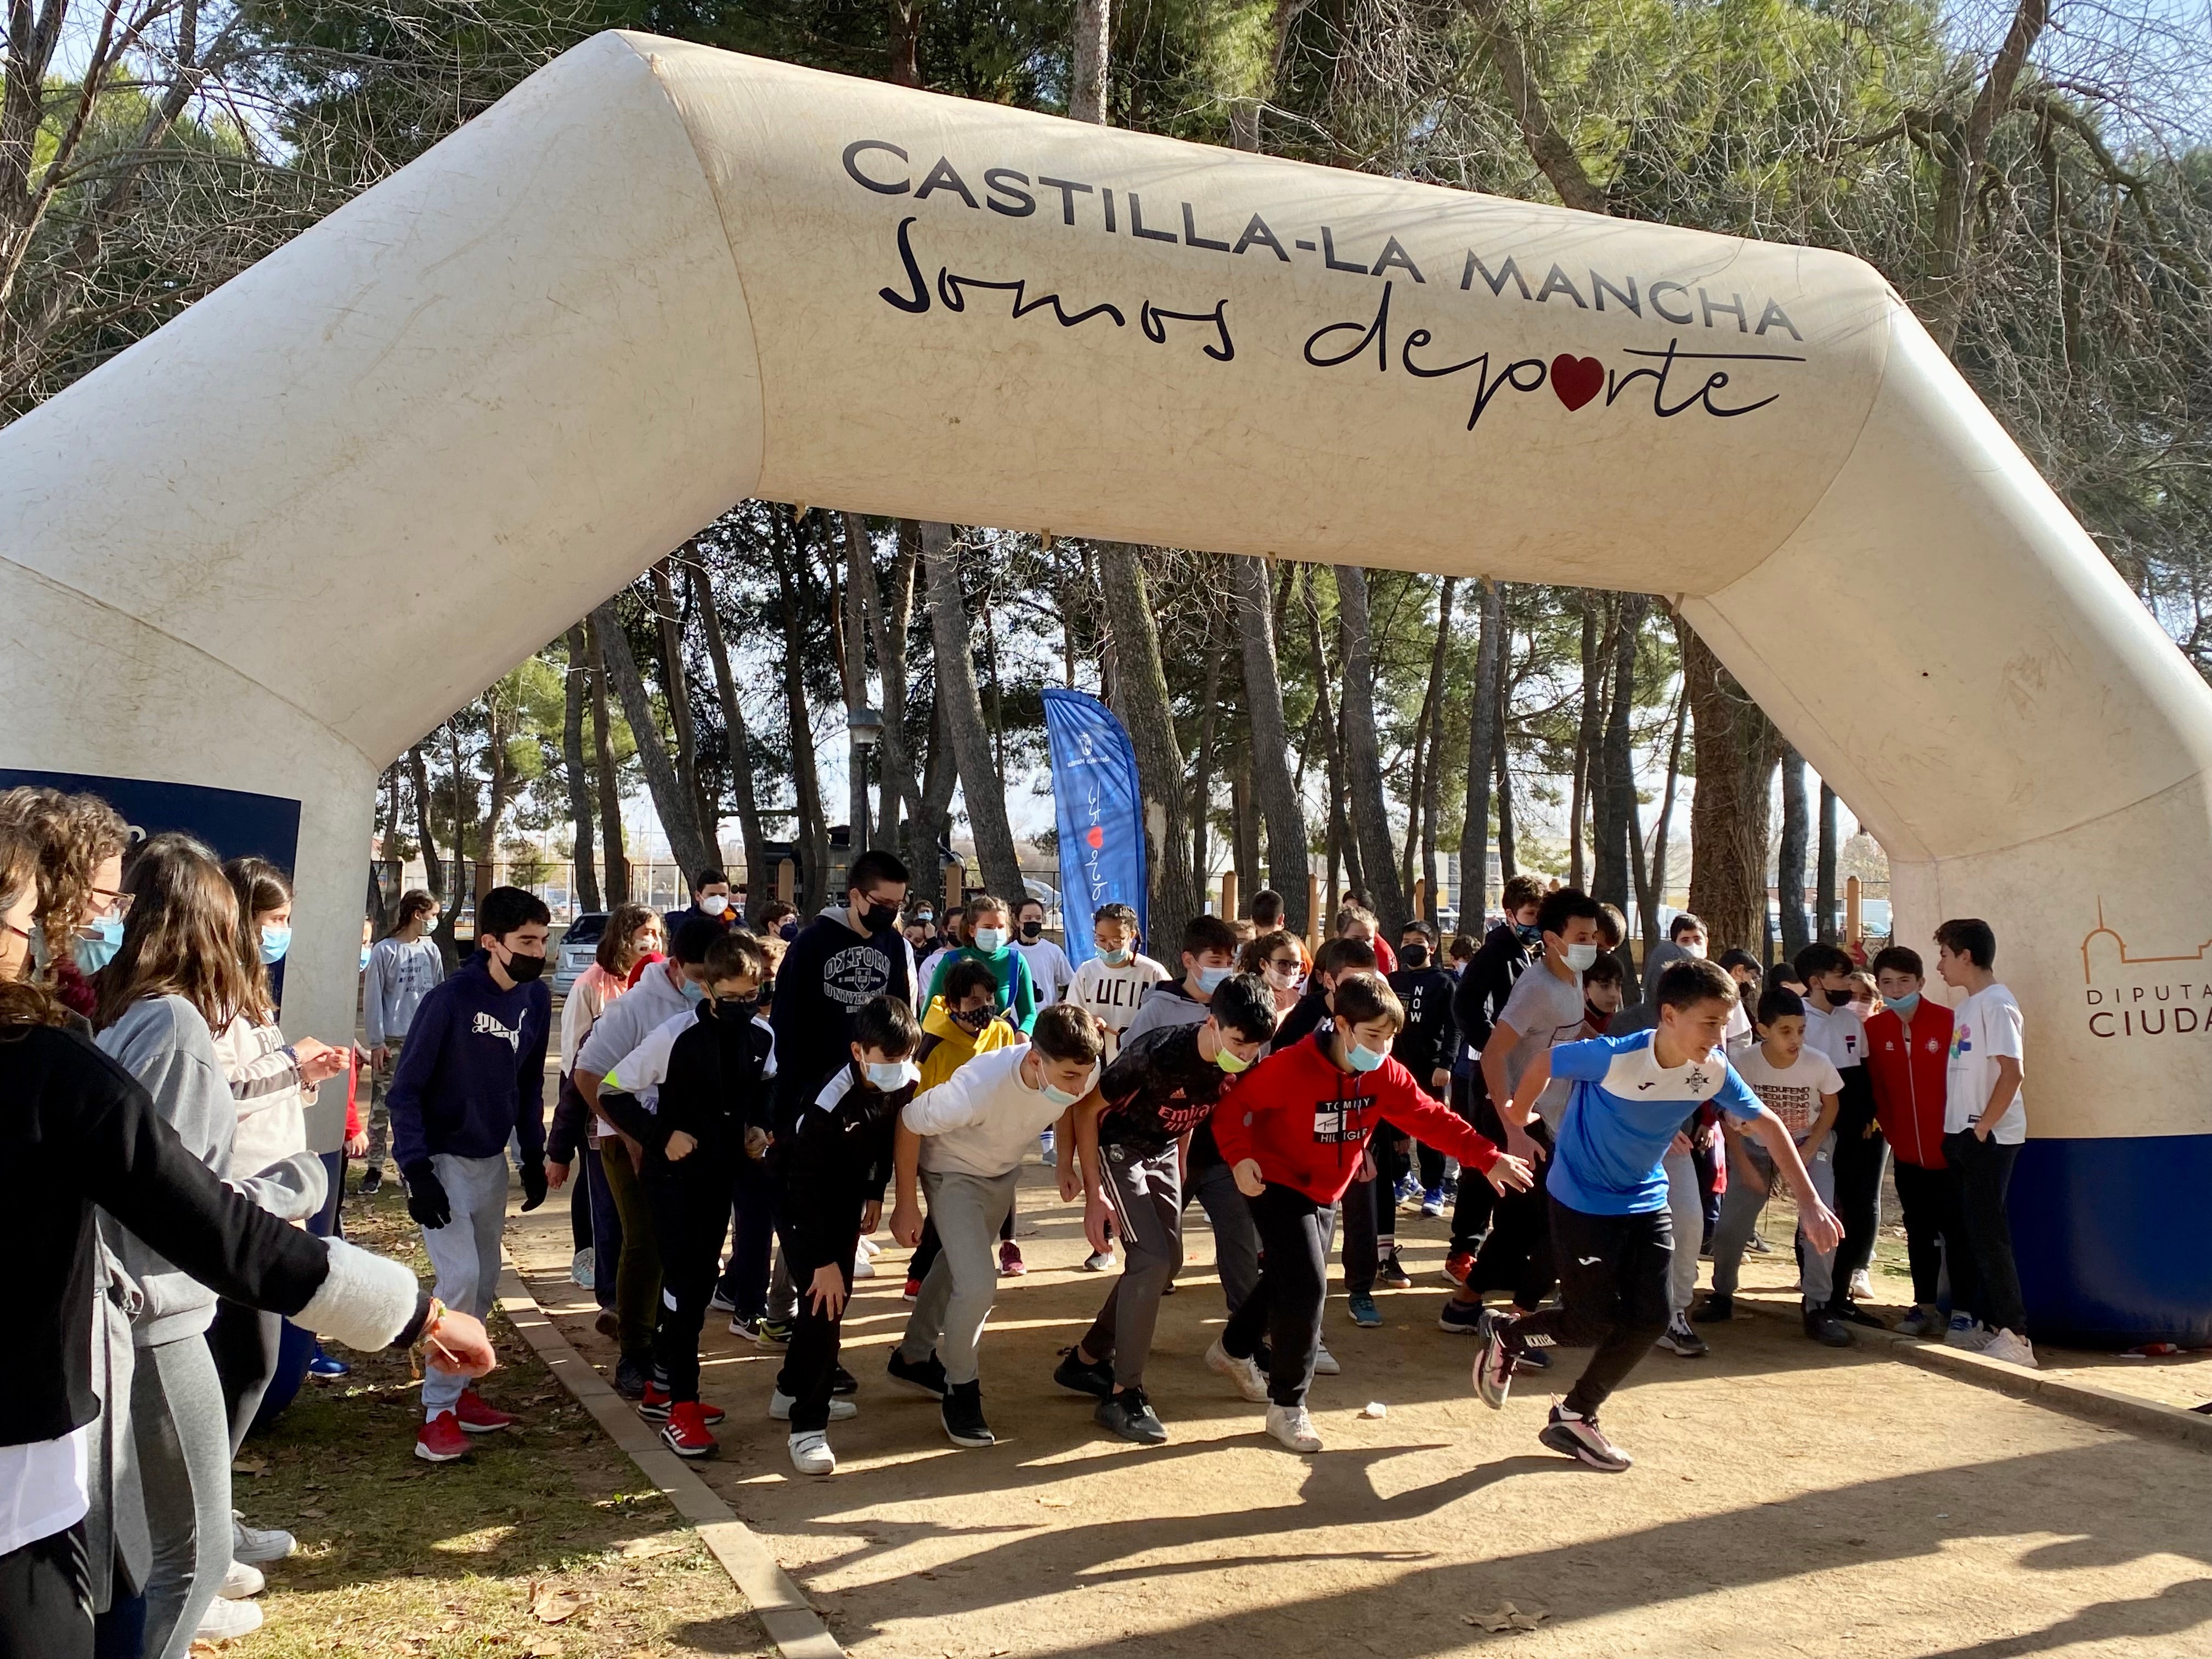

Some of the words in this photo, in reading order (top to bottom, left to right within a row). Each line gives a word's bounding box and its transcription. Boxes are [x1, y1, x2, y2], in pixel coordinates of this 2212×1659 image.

[843, 140, 1426, 283] CASTILLA-LA
[1459, 249, 1804, 341] MANCHA
[824, 946, 890, 980] OXFORD
[824, 981, 888, 1005] UNIVERS
[2087, 984, 2212, 1005] DIPUTA
[1321, 1128, 1368, 1143] HILIGER
